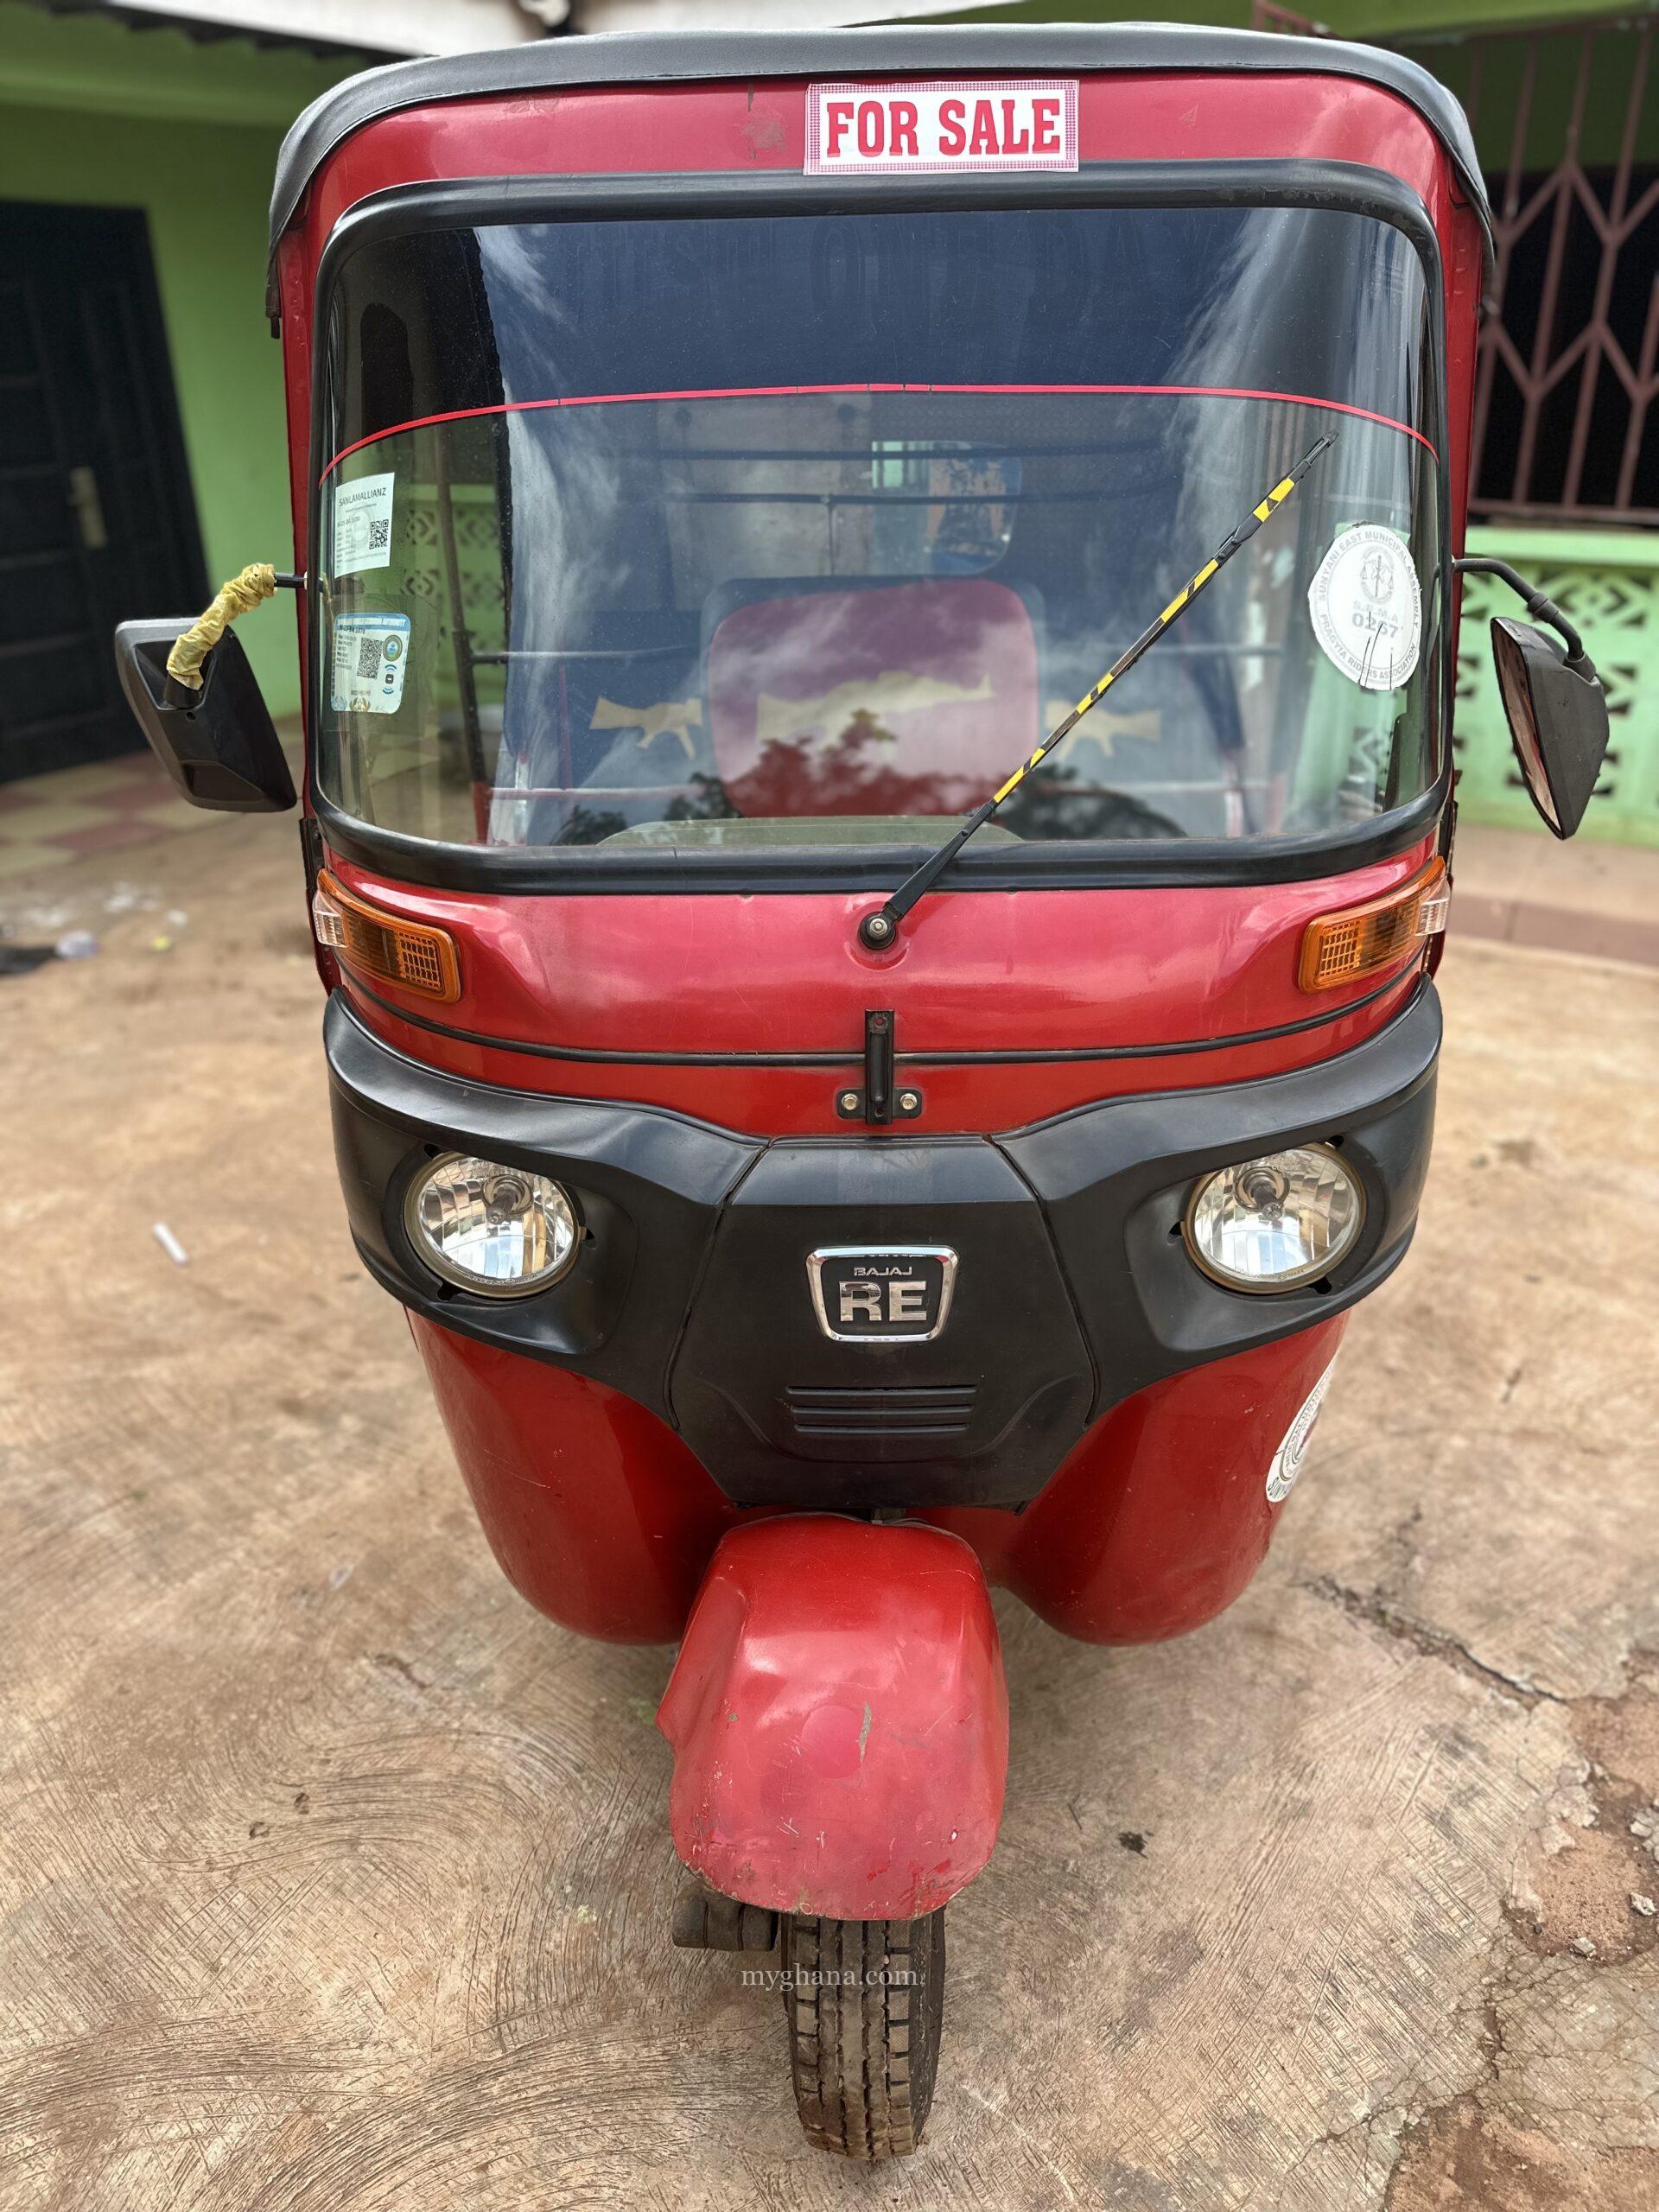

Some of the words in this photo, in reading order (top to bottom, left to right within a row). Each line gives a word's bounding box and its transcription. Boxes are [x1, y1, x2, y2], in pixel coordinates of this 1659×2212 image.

[827, 100, 919, 157] FOR
[938, 99, 1060, 156] SALE
[339, 487, 387, 507] SANLAMALLIANZ
[1319, 550, 1340, 601] SUNYANI
[1339, 532, 1363, 551] EAST
[1364, 531, 1407, 563] MUNICIPAL
[1320, 613, 1347, 659] PRAGYIA
[1347, 657, 1377, 678] RIDERS
[1379, 643, 1415, 679] ASSOCIATION
[854, 1267, 912, 1276] BAJAJ
[839, 1281, 927, 1322] RE
